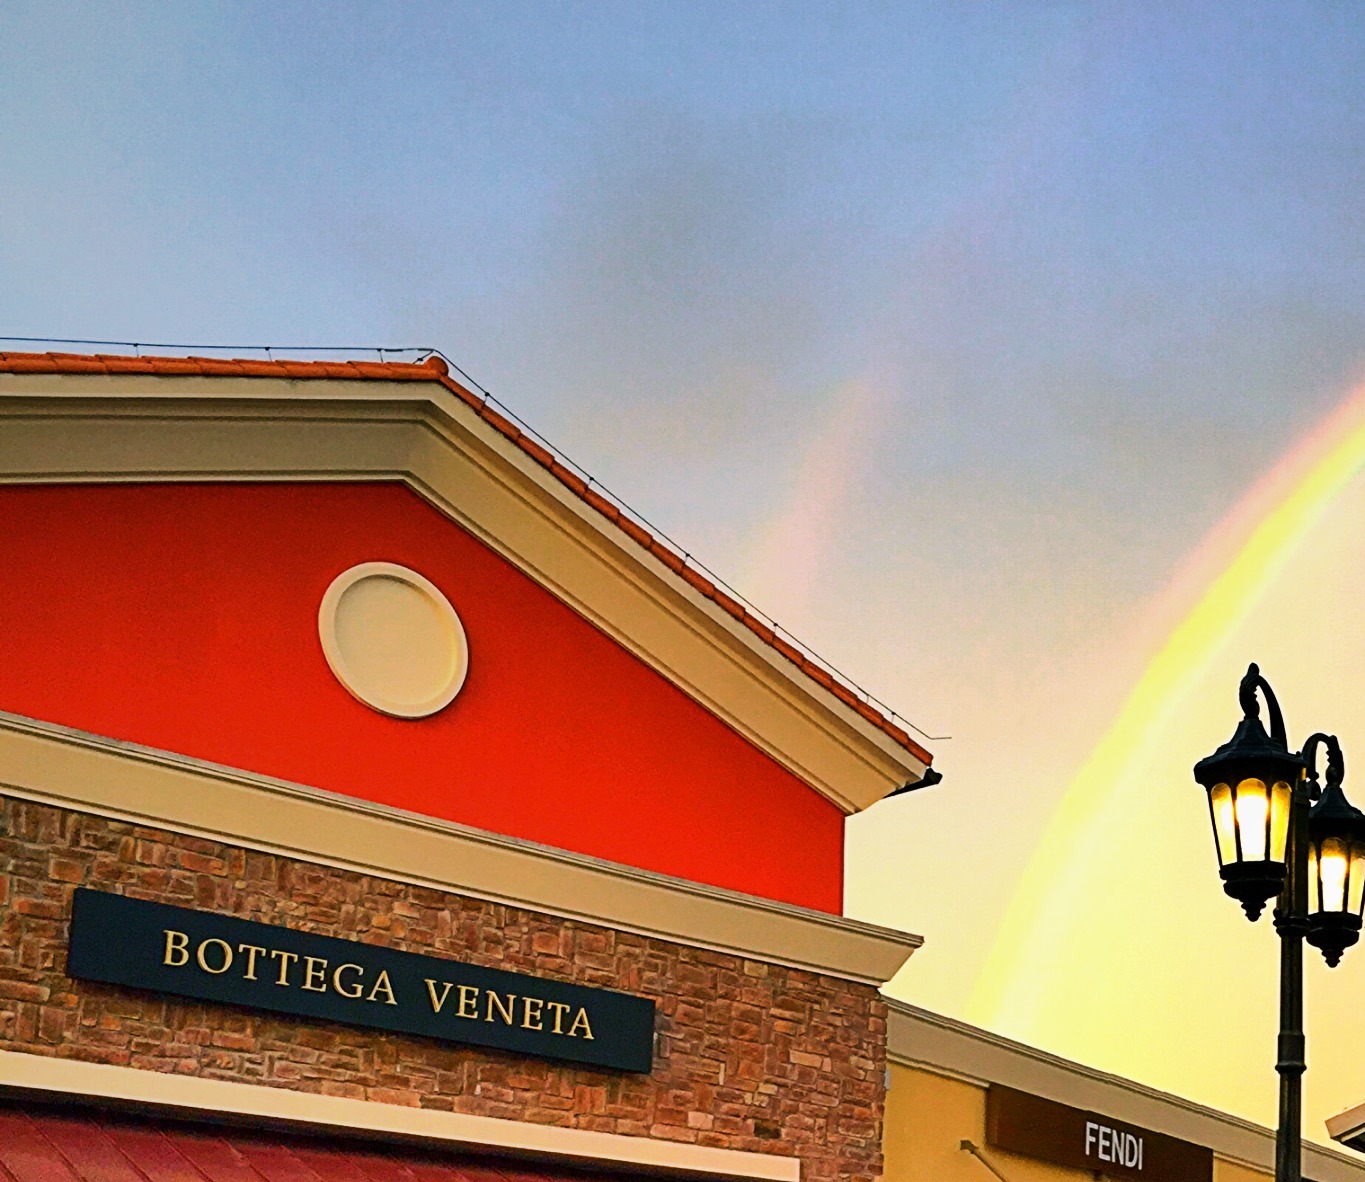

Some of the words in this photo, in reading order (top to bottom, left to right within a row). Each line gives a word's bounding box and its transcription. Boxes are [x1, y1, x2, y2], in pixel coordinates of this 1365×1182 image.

[163, 929, 398, 1005] BOTTEGA
[424, 978, 595, 1041] VENETA
[1085, 1121, 1143, 1171] FENDI
